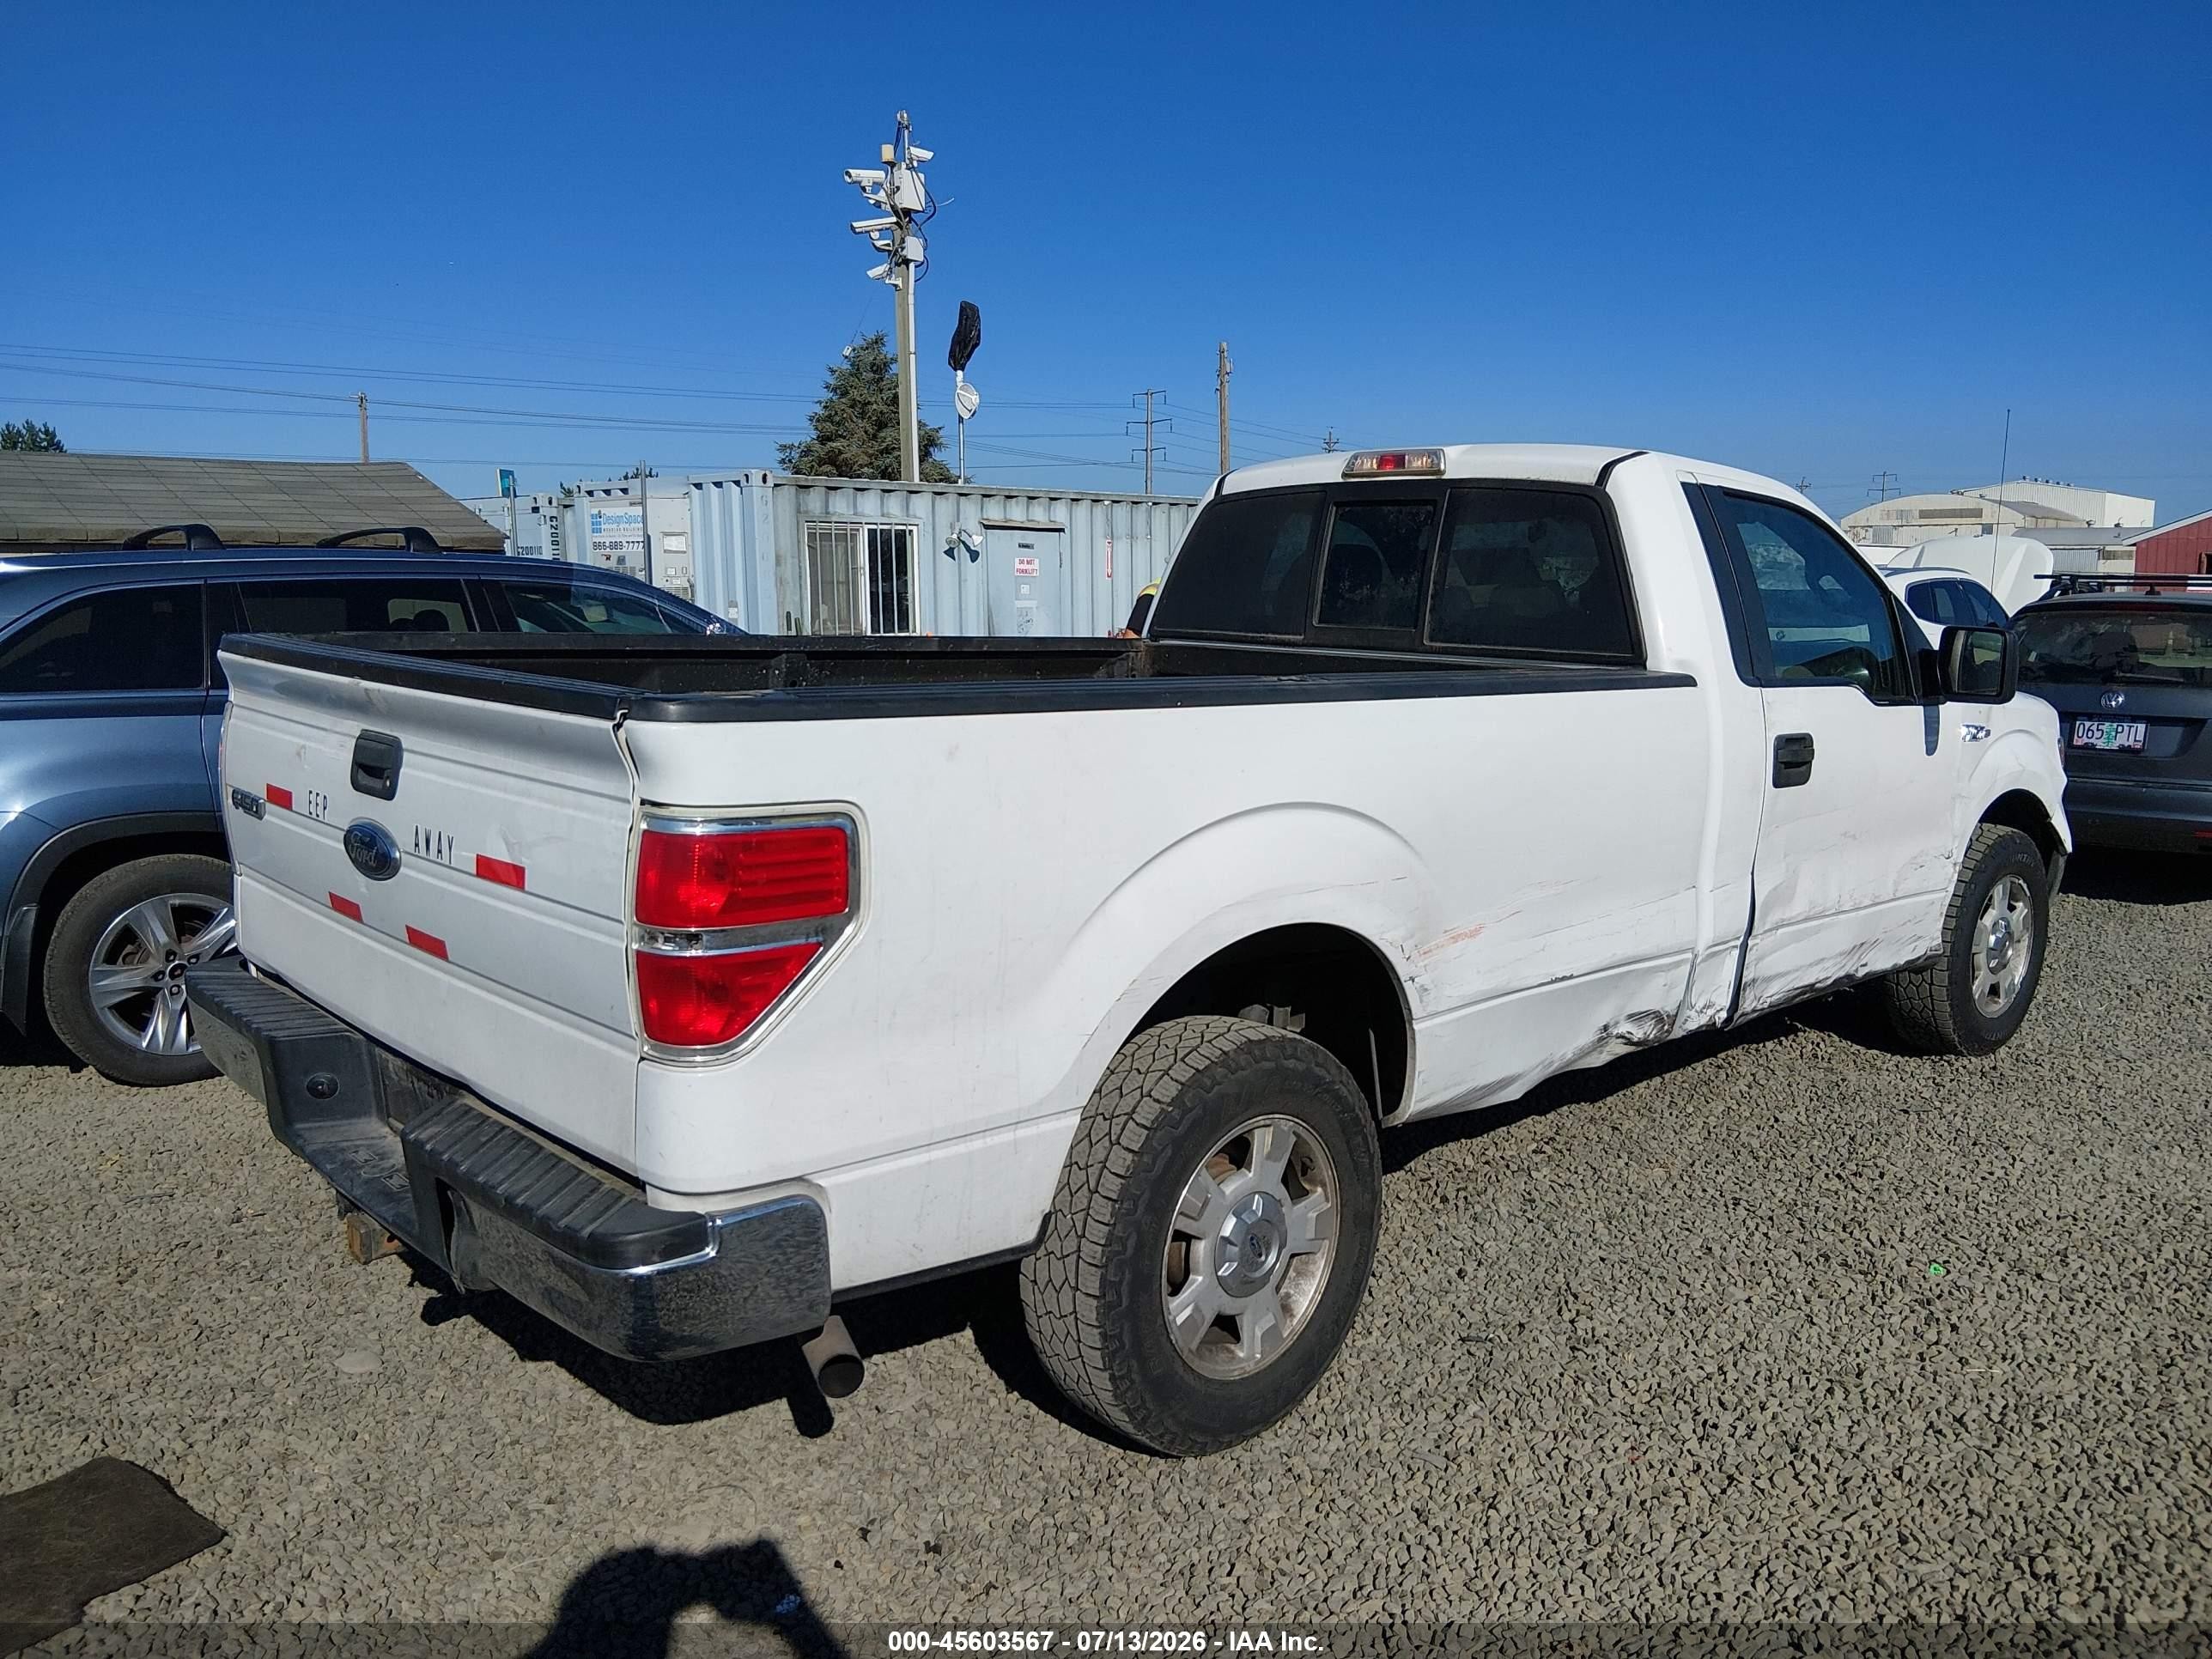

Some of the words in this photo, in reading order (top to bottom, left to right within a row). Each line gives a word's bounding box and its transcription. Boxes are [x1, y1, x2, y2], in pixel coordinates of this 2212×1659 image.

[603, 512, 644, 526] DesignSpac
[550, 515, 561, 561] G20011
[592, 540, 645, 550] 866-889-7777
[2076, 722, 2106, 740] 065
[2115, 724, 2142, 743] PTL
[308, 789, 329, 820] EEP
[414, 824, 455, 865] AWAY
[349, 830, 379, 867] Ford
